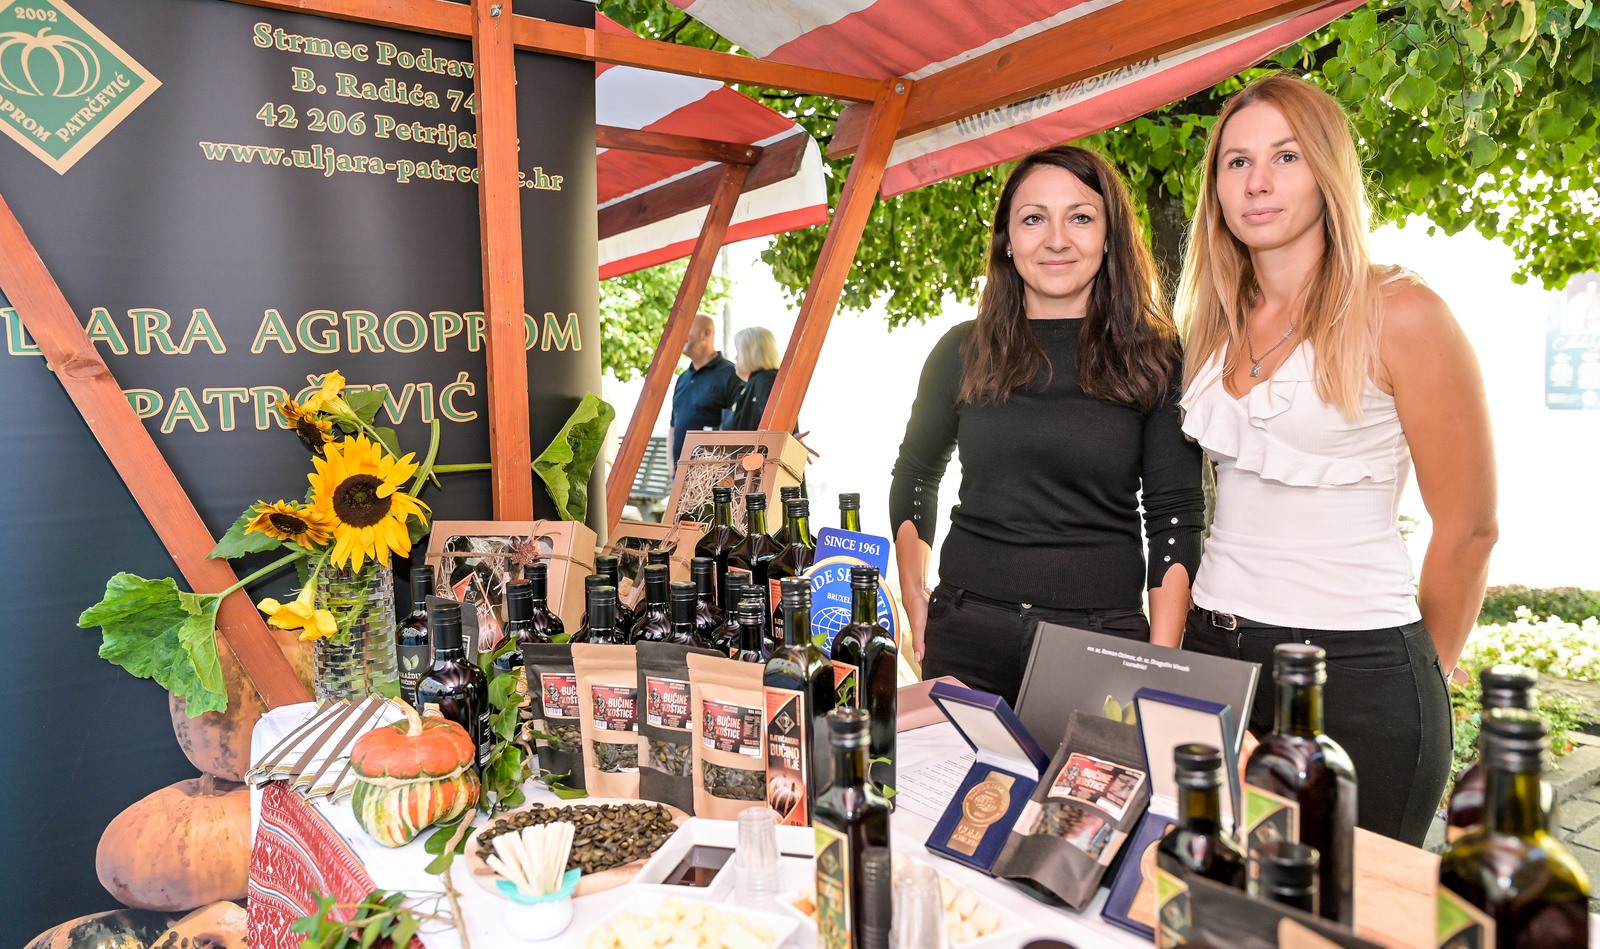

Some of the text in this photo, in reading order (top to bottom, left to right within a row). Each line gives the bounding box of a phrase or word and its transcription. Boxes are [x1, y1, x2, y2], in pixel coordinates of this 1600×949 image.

[14, 6, 58, 23] 2002
[253, 22, 518, 85] Strmec Podrav
[291, 66, 327, 95] B.
[335, 72, 440, 110] Radića
[55, 71, 131, 143] PATRČEVIĆ
[0, 95, 52, 143] PROM
[256, 102, 520, 153] 42 206 Petrija
[199, 141, 564, 191] www.uljara-patrcec.hr
[122, 371, 479, 434] PATRČVIĆ
[824, 535, 881, 556] SINCE 1961
[827, 592, 851, 605] BRUXEL
[608, 696, 634, 710] BUČINE
[663, 692, 689, 706] BUČINE
[716, 714, 742, 730] BUČINE
[770, 743, 800, 760] BUČINO
[783, 757, 800, 771] ULJE
